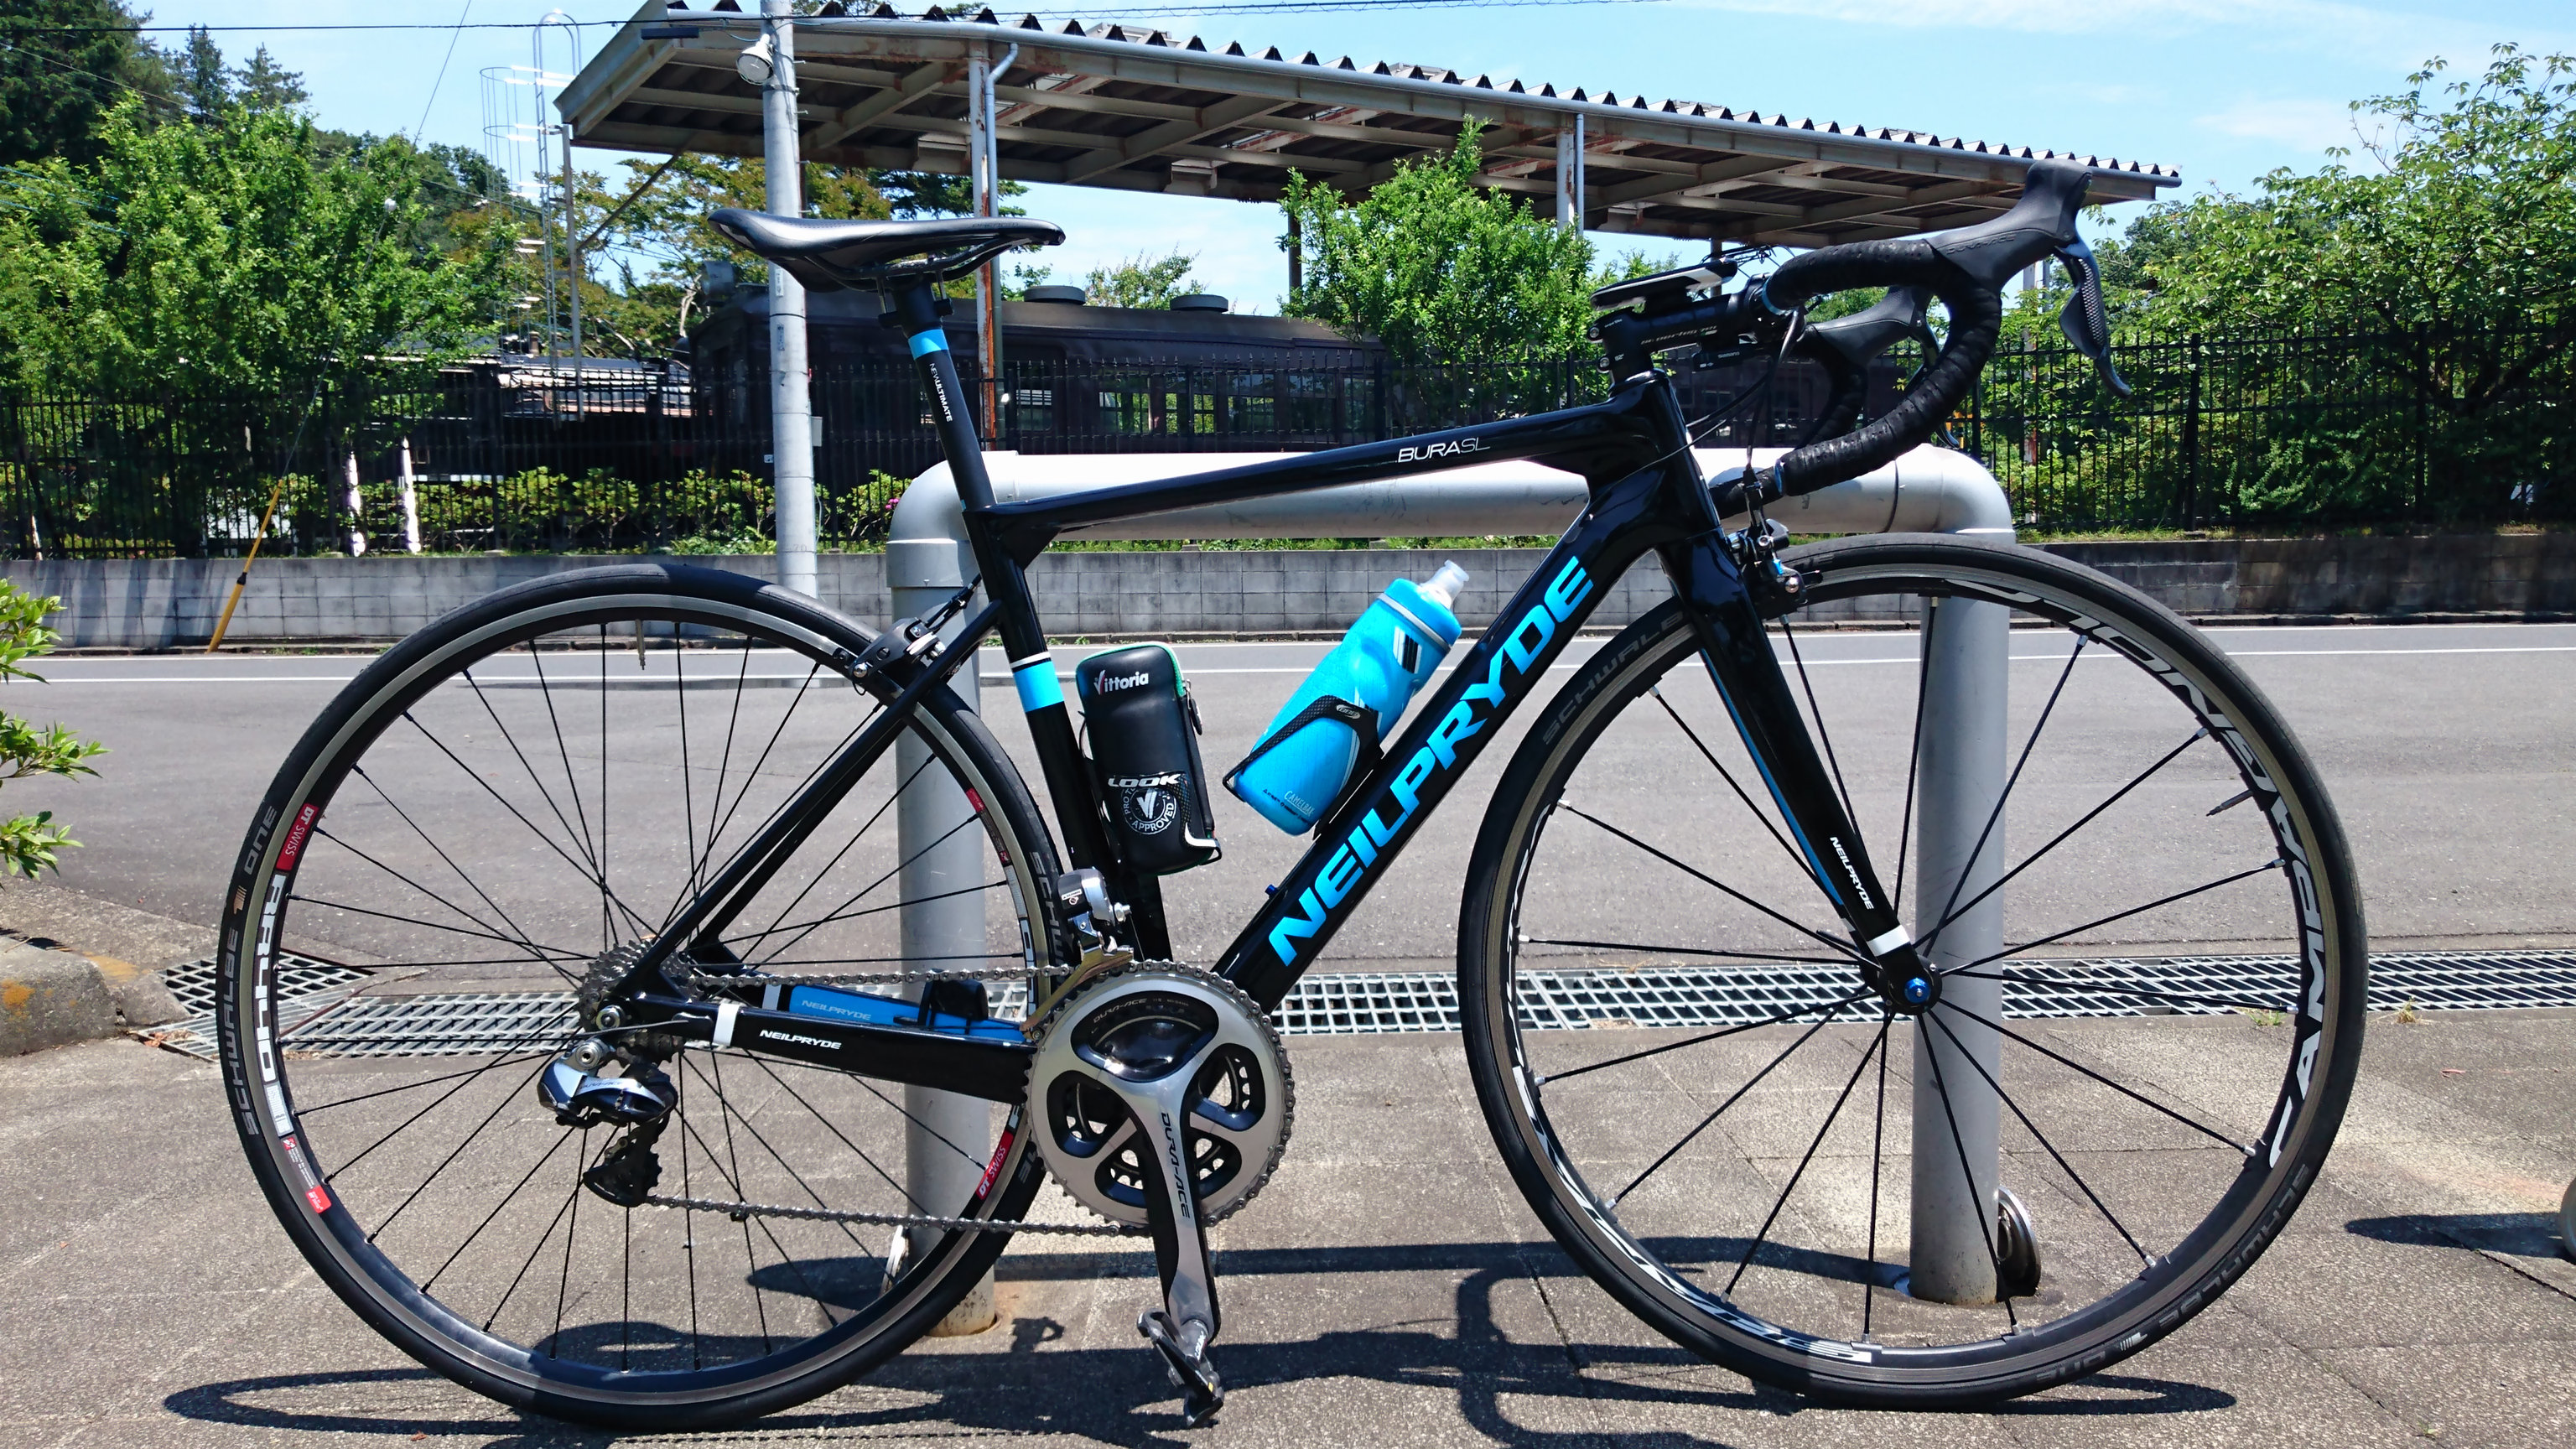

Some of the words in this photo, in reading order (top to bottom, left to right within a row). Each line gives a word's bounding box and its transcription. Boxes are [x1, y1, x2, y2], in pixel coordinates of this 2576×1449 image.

[1093, 669, 1149, 695] Vittoria
[1542, 610, 1684, 745] SCHWALB
[1108, 773, 1180, 788] LOOK
[1267, 555, 1593, 967] NEILPRYDE
[300, 806, 315, 825] DT
[1123, 796, 1131, 815] PRO
[1131, 802, 1175, 832] APPROVED
[243, 805, 278, 875] ONE
[285, 825, 305, 856] SWISS
[1829, 836, 1874, 910] NEILPRYDE
[255, 874, 287, 1082] RR440
[801, 999, 872, 1021] NEILPRYDE
[1093, 998, 1148, 1023] DURA-ACE
[223, 927, 260, 1135] SCHWALBE
[759, 1029, 843, 1050] NEILPRYDE
[979, 1176, 990, 1197] DT
[989, 1145, 1006, 1178] SWISS
[1161, 1112, 1191, 1219] DURA-ACE
[2158, 1163, 2309, 1329] SCHWALBE
